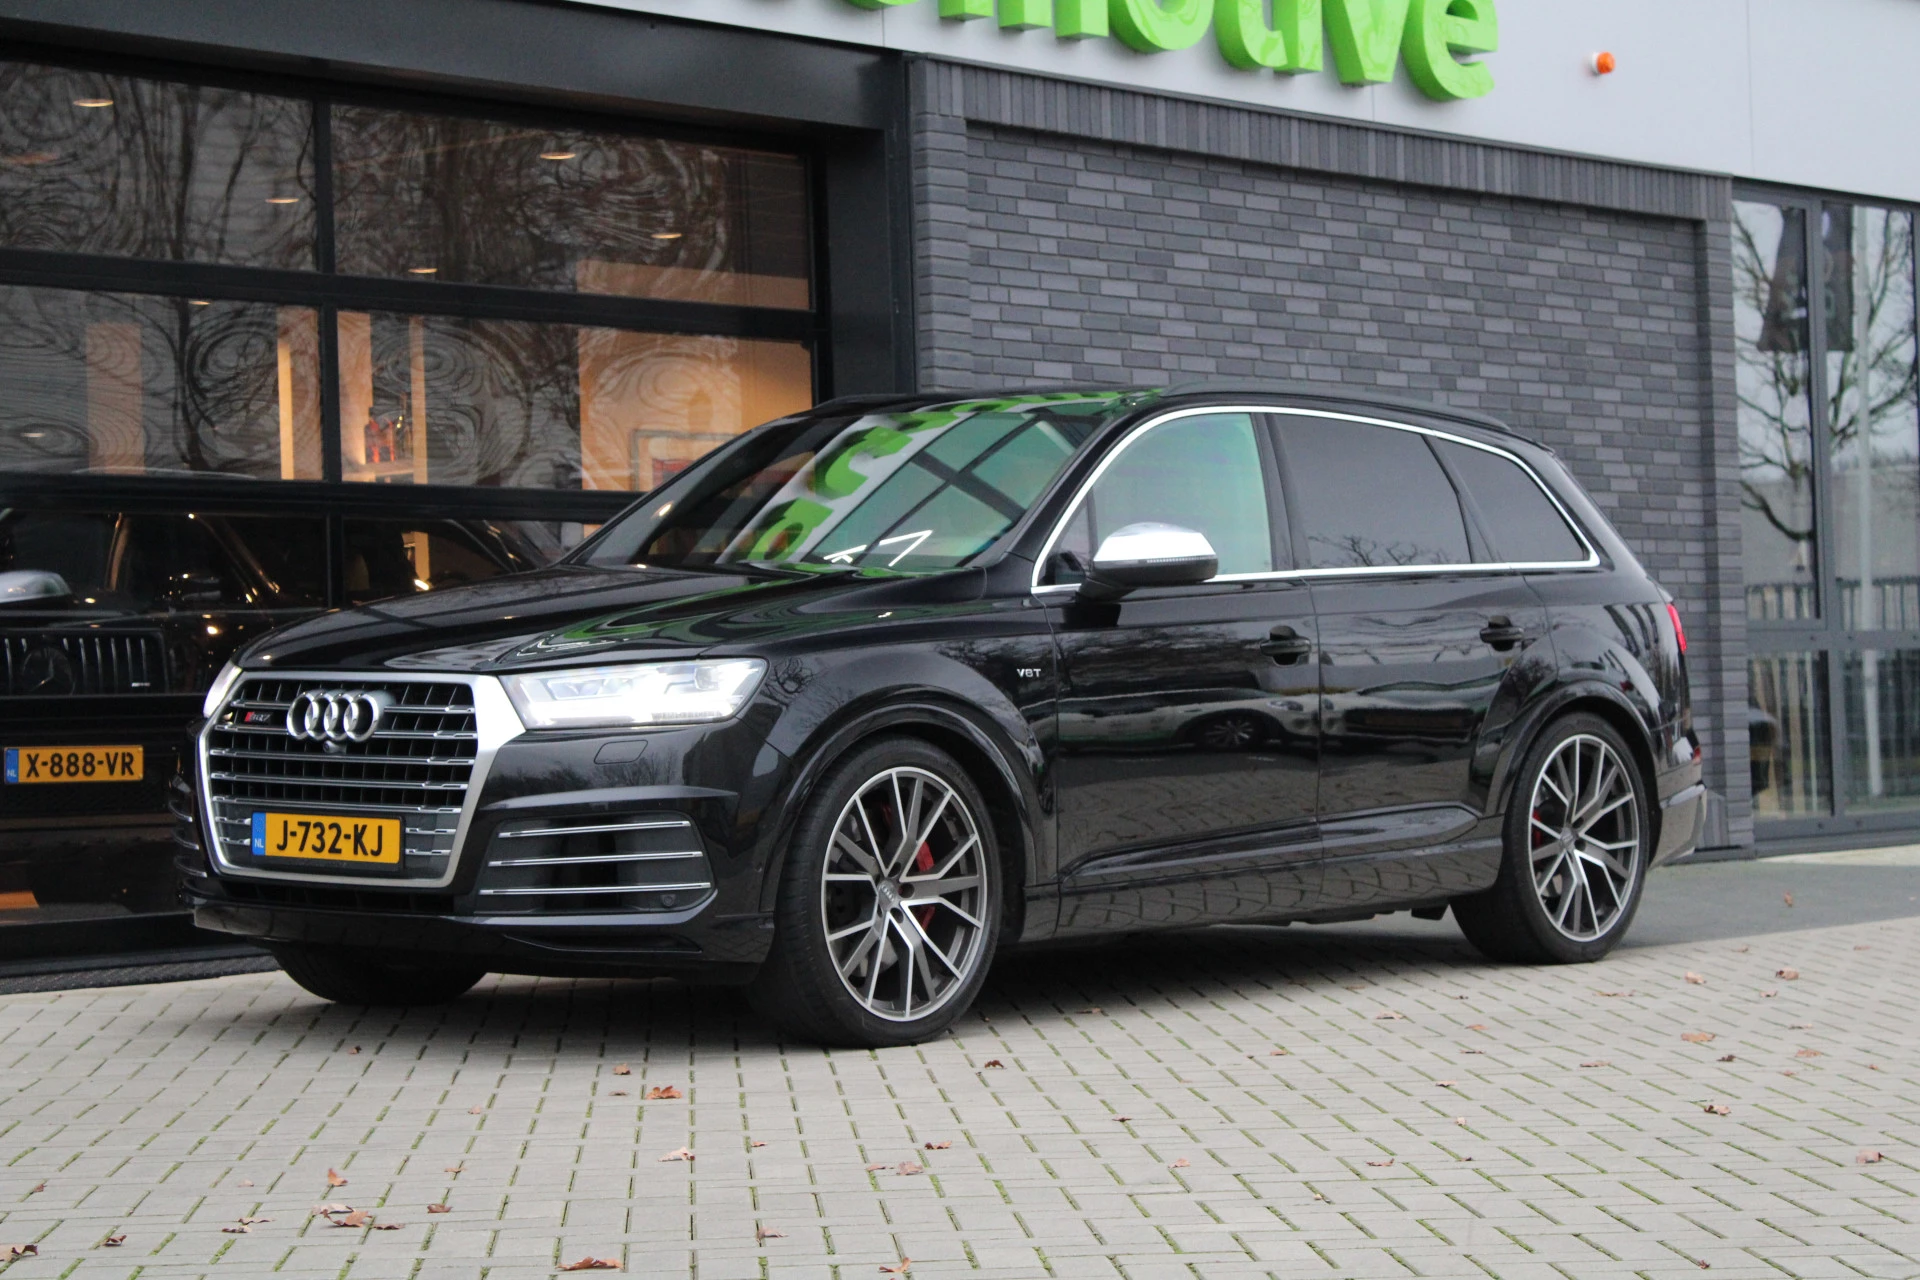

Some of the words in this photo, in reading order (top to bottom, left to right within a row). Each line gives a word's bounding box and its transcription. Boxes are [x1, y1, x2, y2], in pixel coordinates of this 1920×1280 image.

[7, 769, 17, 778] NL
[26, 751, 135, 778] X-888-VR
[254, 838, 264, 849] NL
[276, 819, 383, 857] J-732-KJ
